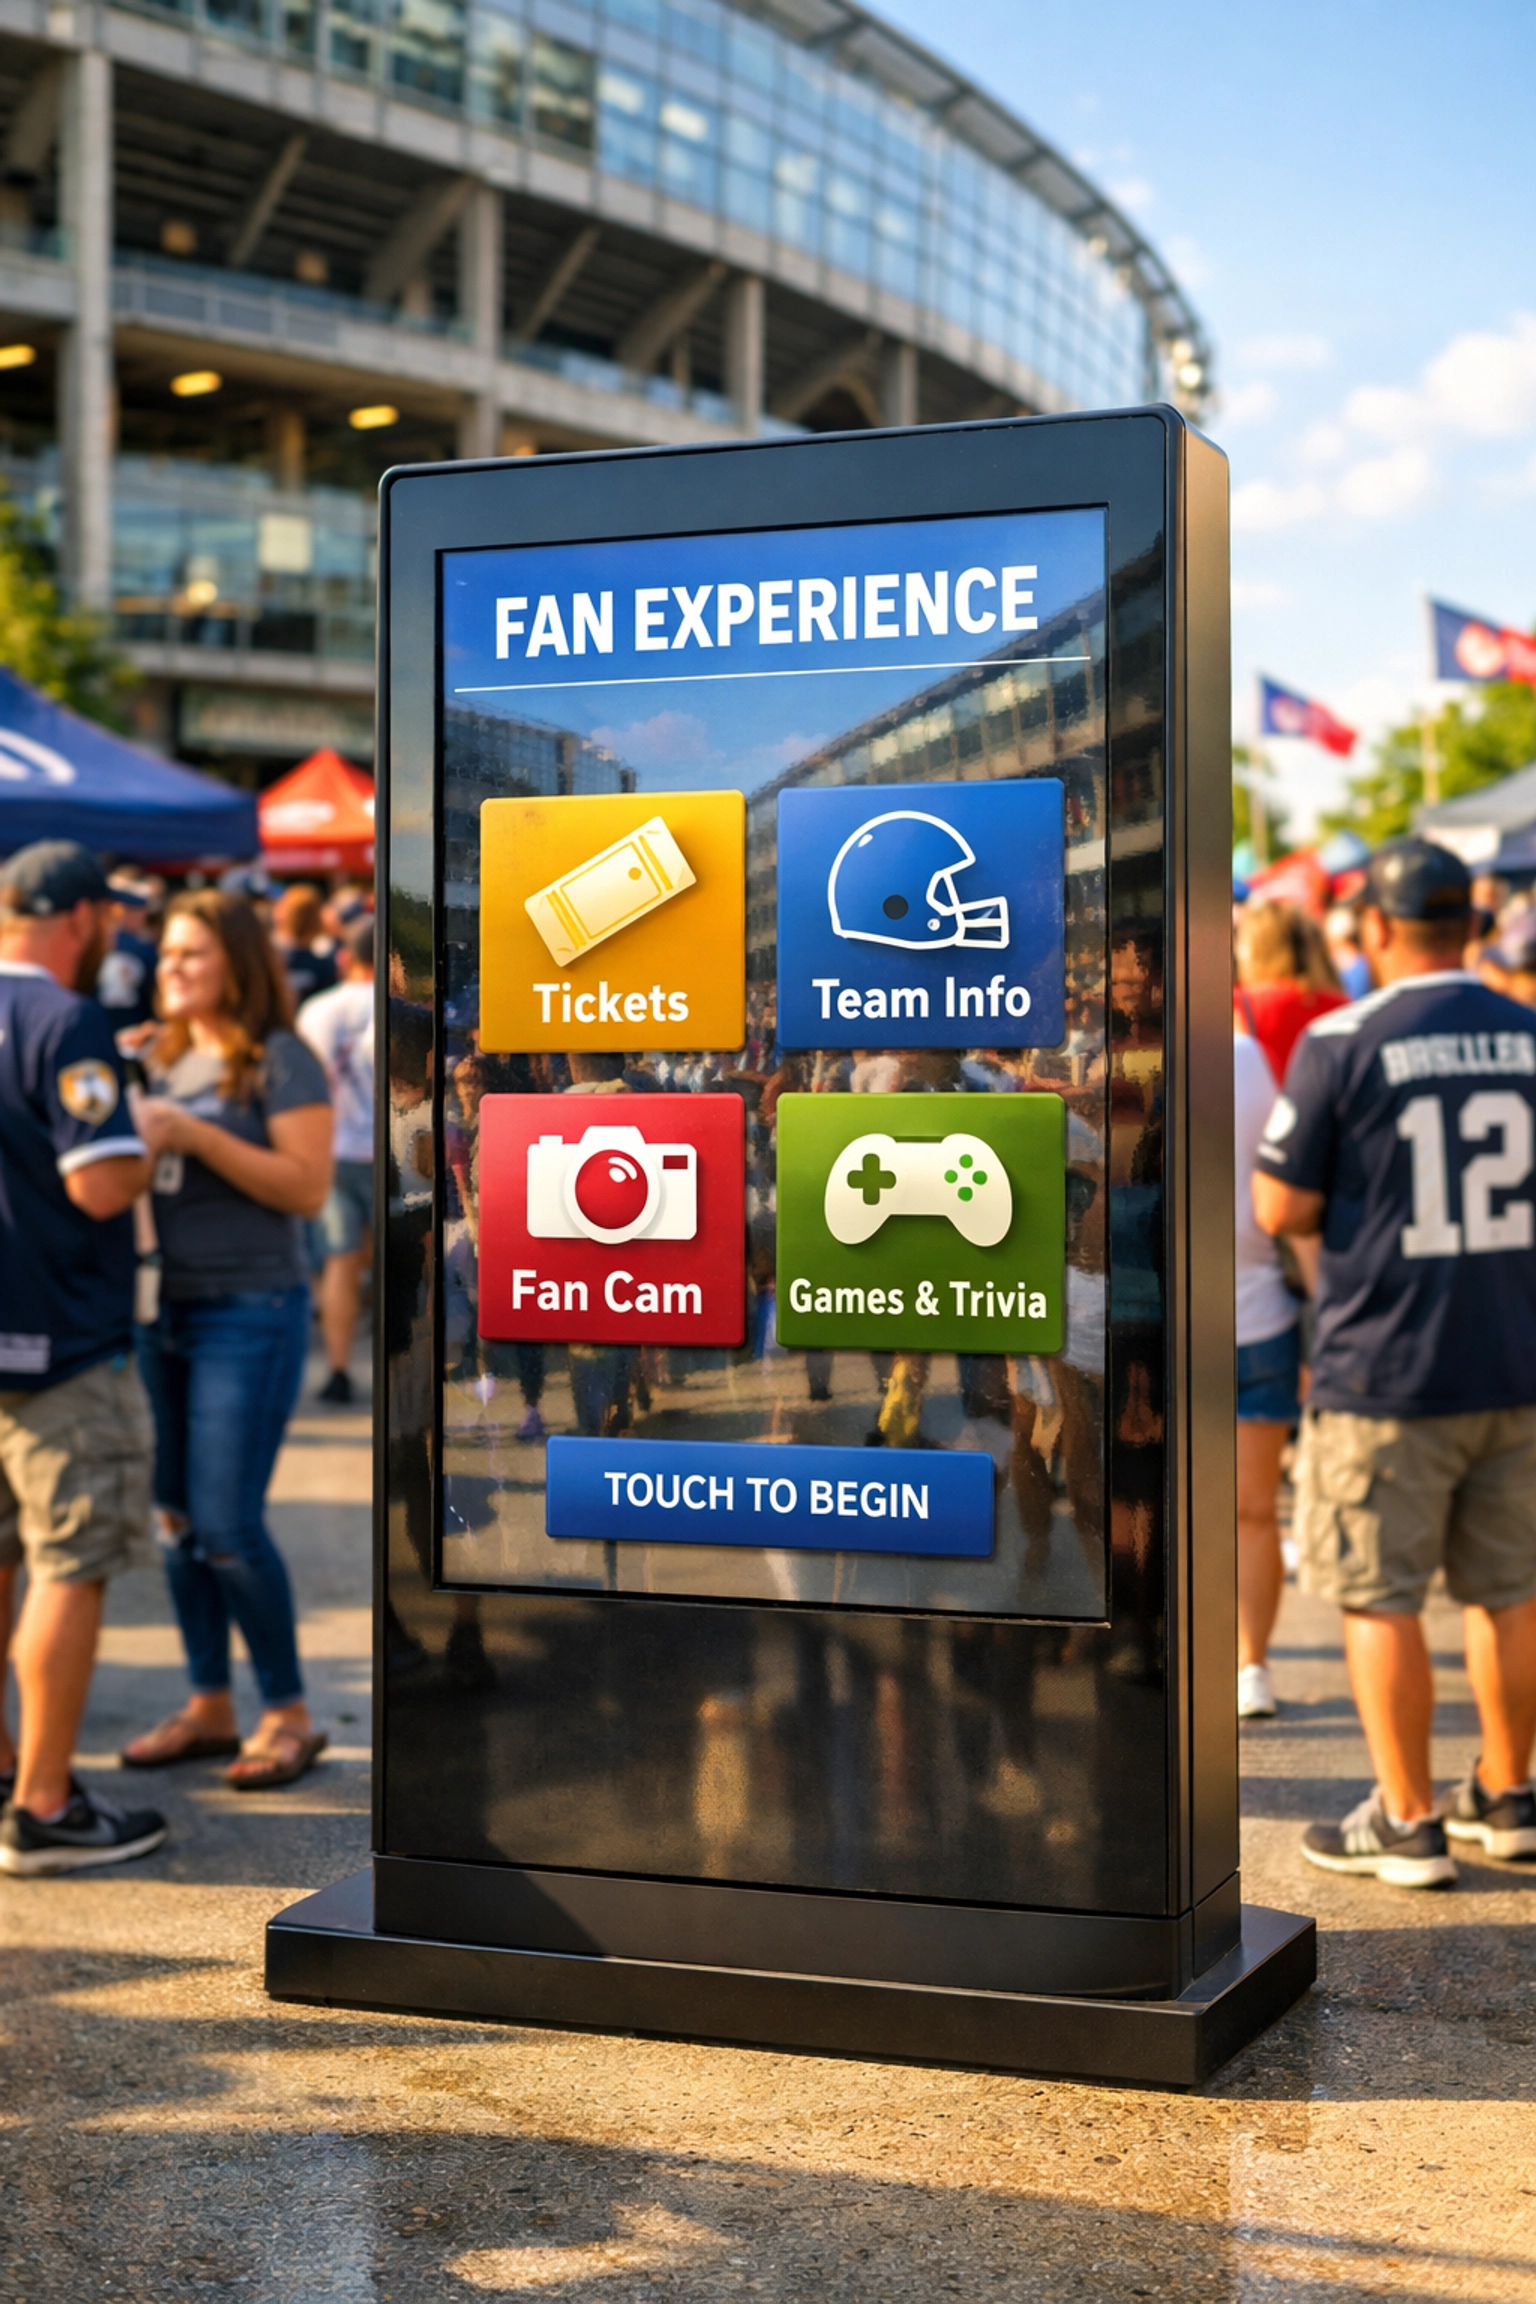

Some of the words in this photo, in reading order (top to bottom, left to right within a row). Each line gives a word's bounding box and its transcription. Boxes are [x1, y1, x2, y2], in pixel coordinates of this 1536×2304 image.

[496, 590, 613, 659] FAN
[635, 565, 1039, 652] EXPERIENCE
[533, 981, 689, 1023] Tickets
[812, 978, 929, 1020] Team
[946, 974, 1031, 1018] Info
[1397, 1090, 1534, 1258] 12
[512, 1269, 588, 1311] Fan
[604, 1270, 702, 1314] Cam
[789, 1278, 904, 1315] Games
[915, 1280, 940, 1316] &
[950, 1281, 1047, 1319] Trivia
[604, 1471, 734, 1511] TOUCH
[746, 1477, 798, 1514] TO
[810, 1480, 930, 1519] BEGIN
